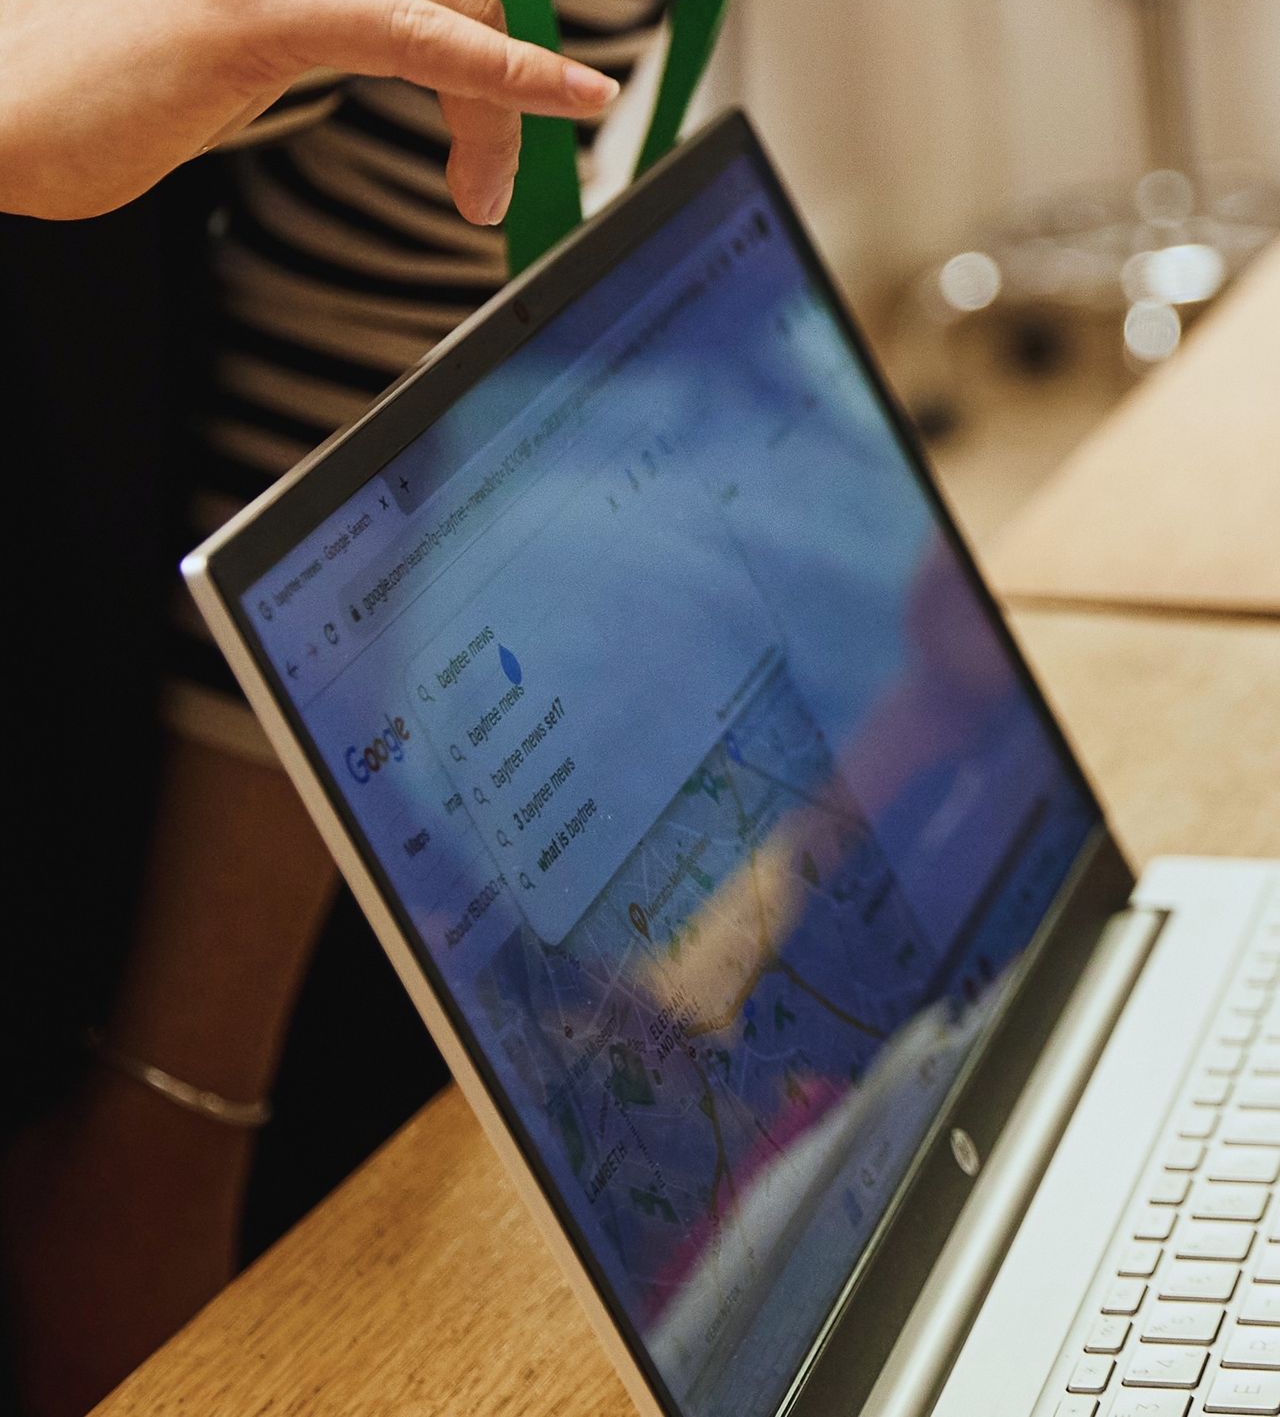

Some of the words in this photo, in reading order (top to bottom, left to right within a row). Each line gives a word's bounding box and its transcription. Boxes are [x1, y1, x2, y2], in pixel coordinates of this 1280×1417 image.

[323, 530, 351, 561] Google
[434, 648, 470, 688] baytree
[466, 623, 494, 658] mews
[465, 705, 501, 747] baytree
[498, 686, 525, 715] mews
[488, 746, 524, 789] baytree
[520, 721, 547, 757] mews
[543, 694, 565, 730] se17
[344, 712, 410, 786] Google
[549, 755, 576, 791] mews
[513, 813, 524, 830] 3
[518, 781, 553, 824] baytree
[536, 836, 562, 873] what
[555, 830, 570, 850] is
[563, 797, 597, 839] baytree
[649, 986, 687, 1040] ELEPHANT
[657, 1033, 674, 1063] AND
[584, 1140, 628, 1204] LAMBETH
